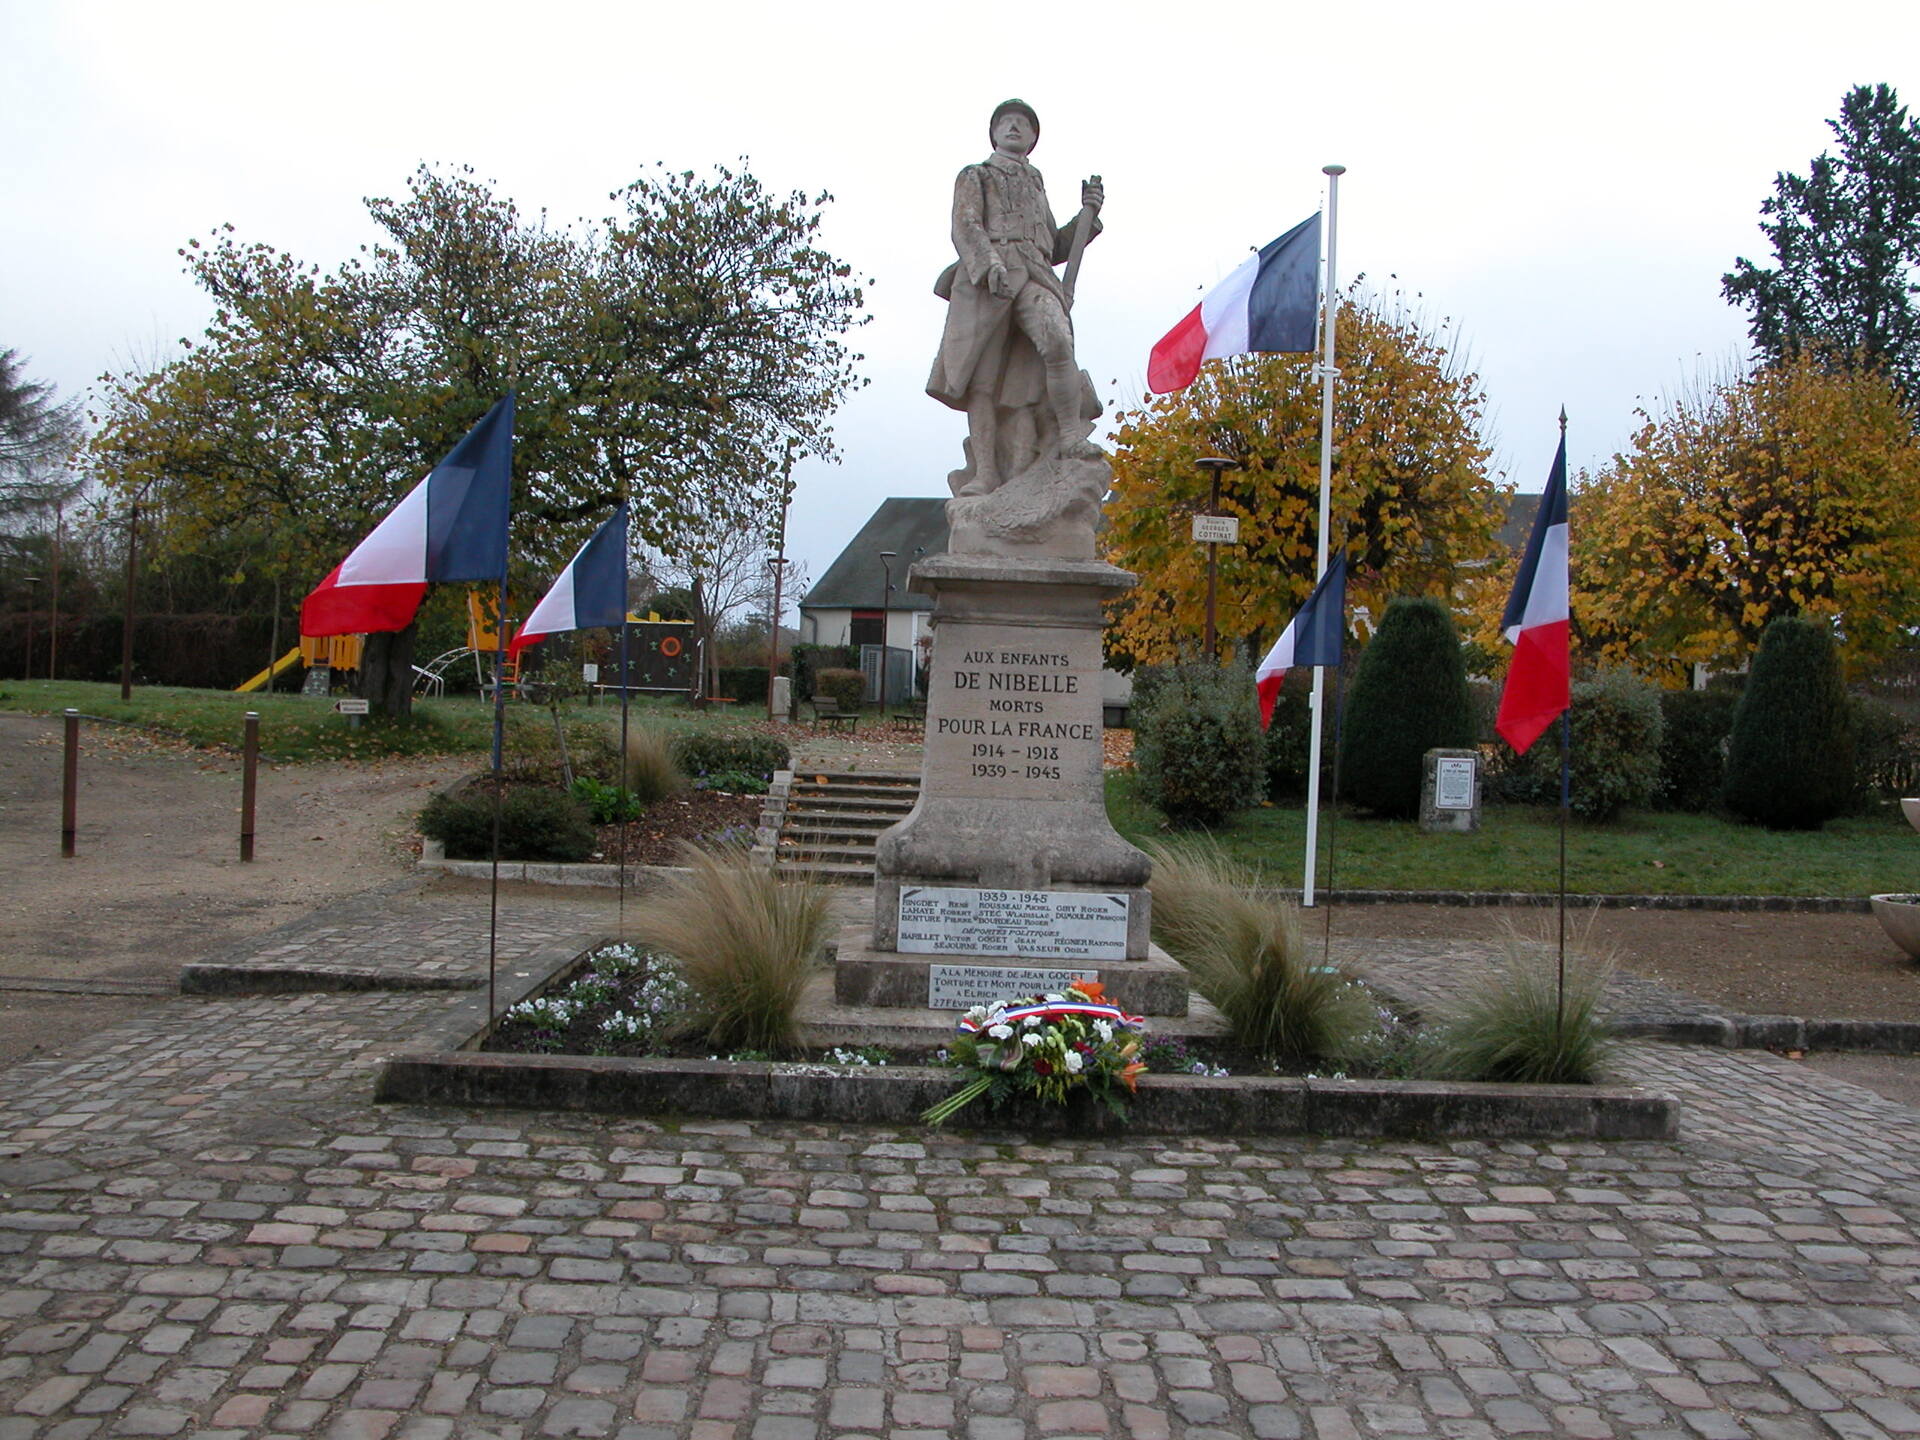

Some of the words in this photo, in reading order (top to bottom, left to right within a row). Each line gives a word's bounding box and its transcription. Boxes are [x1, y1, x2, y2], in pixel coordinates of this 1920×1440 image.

[1198, 531, 1232, 540] COTTINAT
[964, 652, 994, 664] AUX
[1001, 652, 1070, 667] ENFANTS
[954, 671, 980, 690] DE
[988, 672, 1078, 694] NIBELLE
[990, 700, 1044, 713] MORTS
[938, 718, 986, 735] POUR
[992, 722, 1012, 736] LA
[1018, 722, 1093, 740] FRANCE
[972, 744, 1005, 758] 1914
[1027, 746, 1059, 760] 1918
[972, 764, 1006, 778] 1939
[1026, 766, 1060, 780] 1945
[979, 892, 1008, 901] 1939
[1020, 894, 1048, 904] 1945
[978, 902, 1022, 910] ROUSSEAU
[940, 908, 972, 916] ROBERT
[1056, 912, 1094, 920] DUMOULIN
[1008, 929, 1059, 938] POLITIQUES
[1088, 940, 1124, 948] RAYMOND
[940, 968, 948, 976] A
[949, 968, 960, 976] LA
[1008, 970, 1018, 979] DE
[1020, 970, 1044, 980] JEAN
[1048, 972, 1086, 980] GOGET
[977, 980, 988, 988] ET
[990, 980, 1016, 989] MORT
[1019, 982, 1042, 990] POUR
[934, 998, 945, 1007] 27
